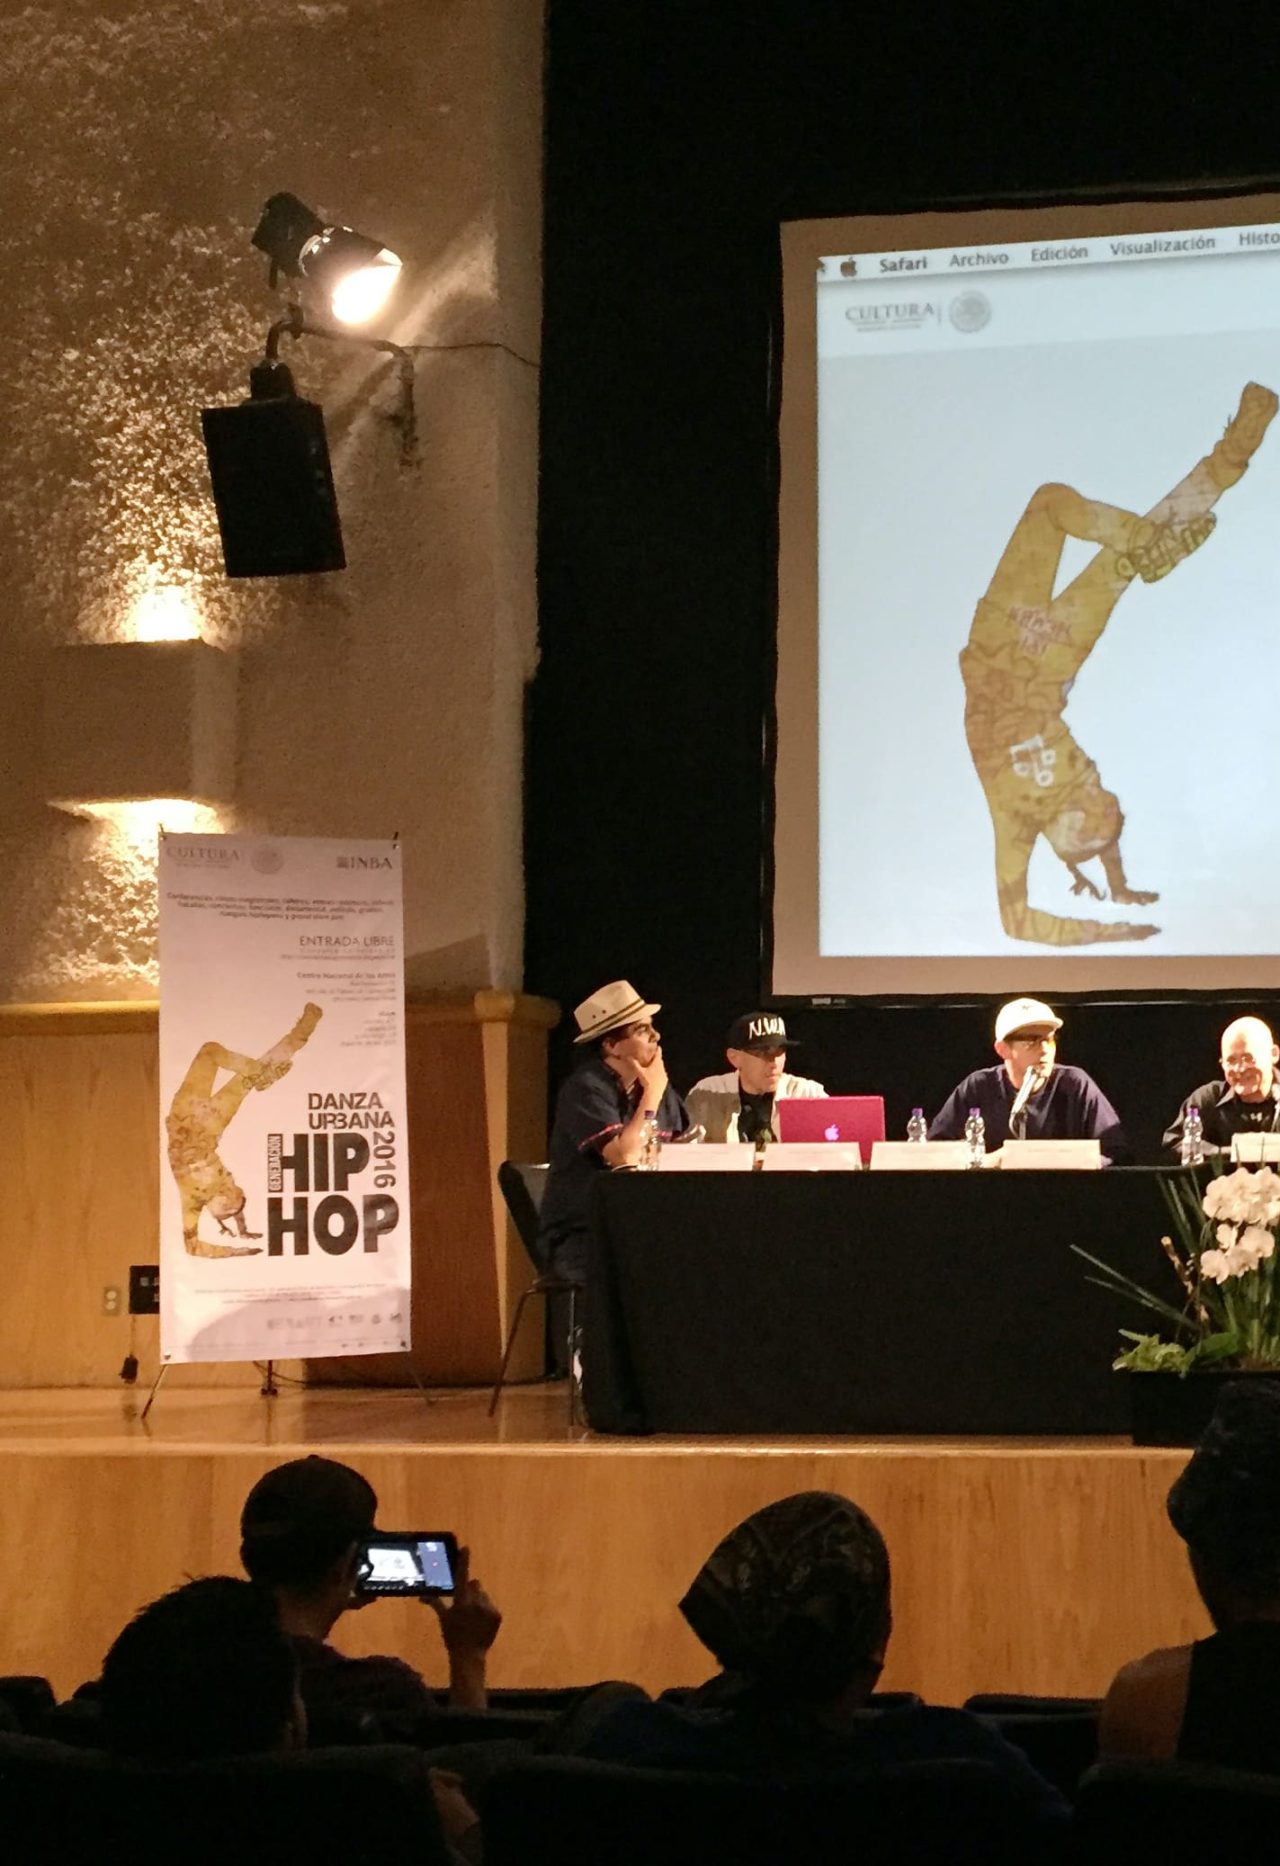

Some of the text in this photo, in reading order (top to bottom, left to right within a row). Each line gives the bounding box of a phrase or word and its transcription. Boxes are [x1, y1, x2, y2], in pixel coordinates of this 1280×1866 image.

[879, 256, 928, 273] Safari
[949, 252, 1009, 268] Archivo
[1031, 246, 1089, 262] Edición
[1110, 235, 1216, 257] Visualización
[845, 302, 935, 321] CULTURA
[308, 1092, 384, 1110] DANZA
[267, 1132, 370, 1193] HIP
[373, 1131, 397, 1189] 2016
[267, 1194, 400, 1257] HOP
